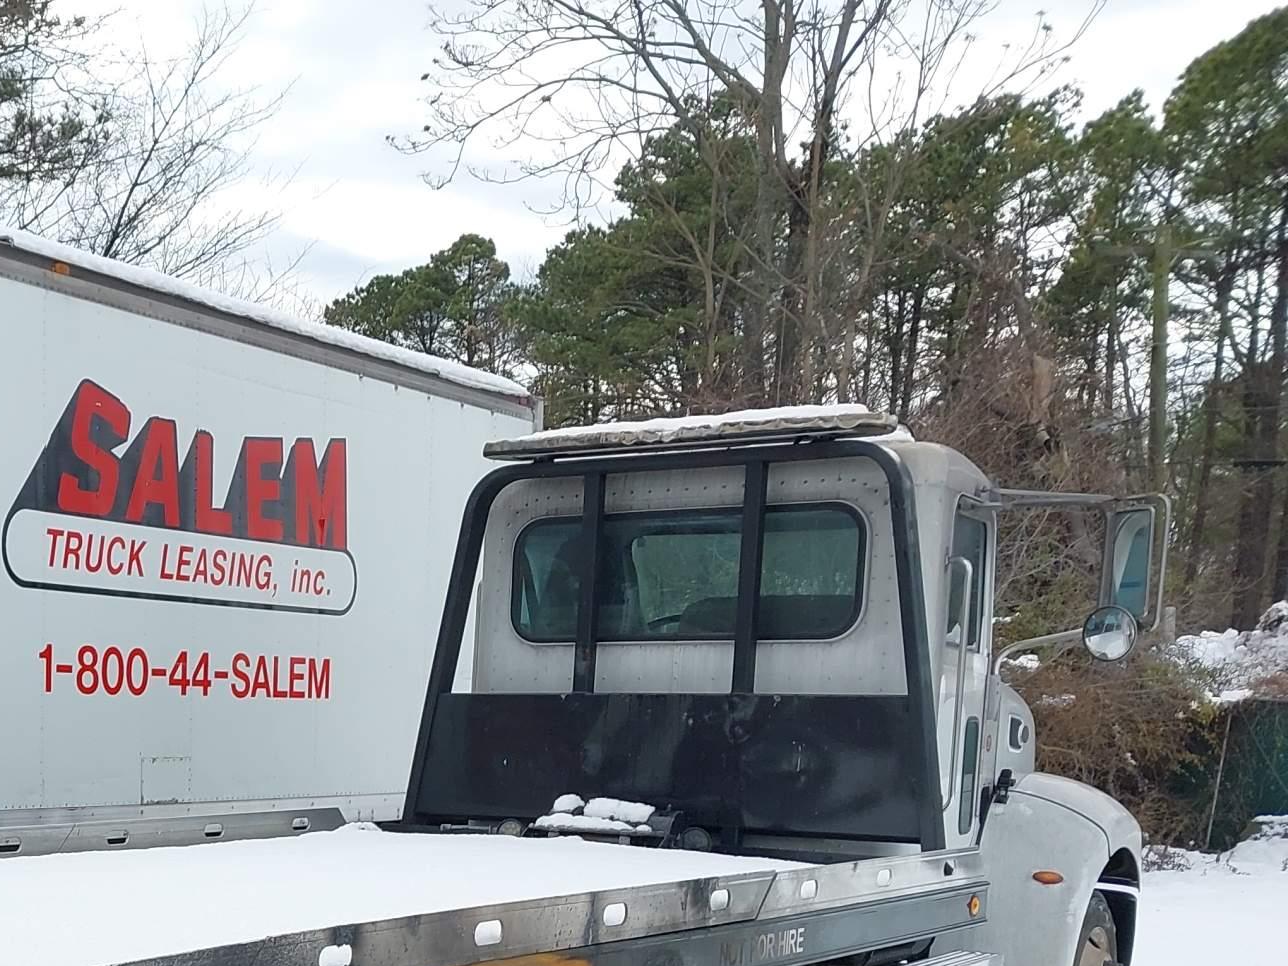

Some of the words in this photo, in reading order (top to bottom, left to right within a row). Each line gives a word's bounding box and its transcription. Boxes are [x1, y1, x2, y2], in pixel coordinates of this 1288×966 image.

[53, 378, 349, 551] SALEM
[46, 527, 148, 578] TRUCK
[159, 543, 279, 598] LEASING,
[291, 559, 332, 596] inc.
[38, 643, 331, 700] 1-800-44-SALEM
[776, 927, 806, 957] HIRE
